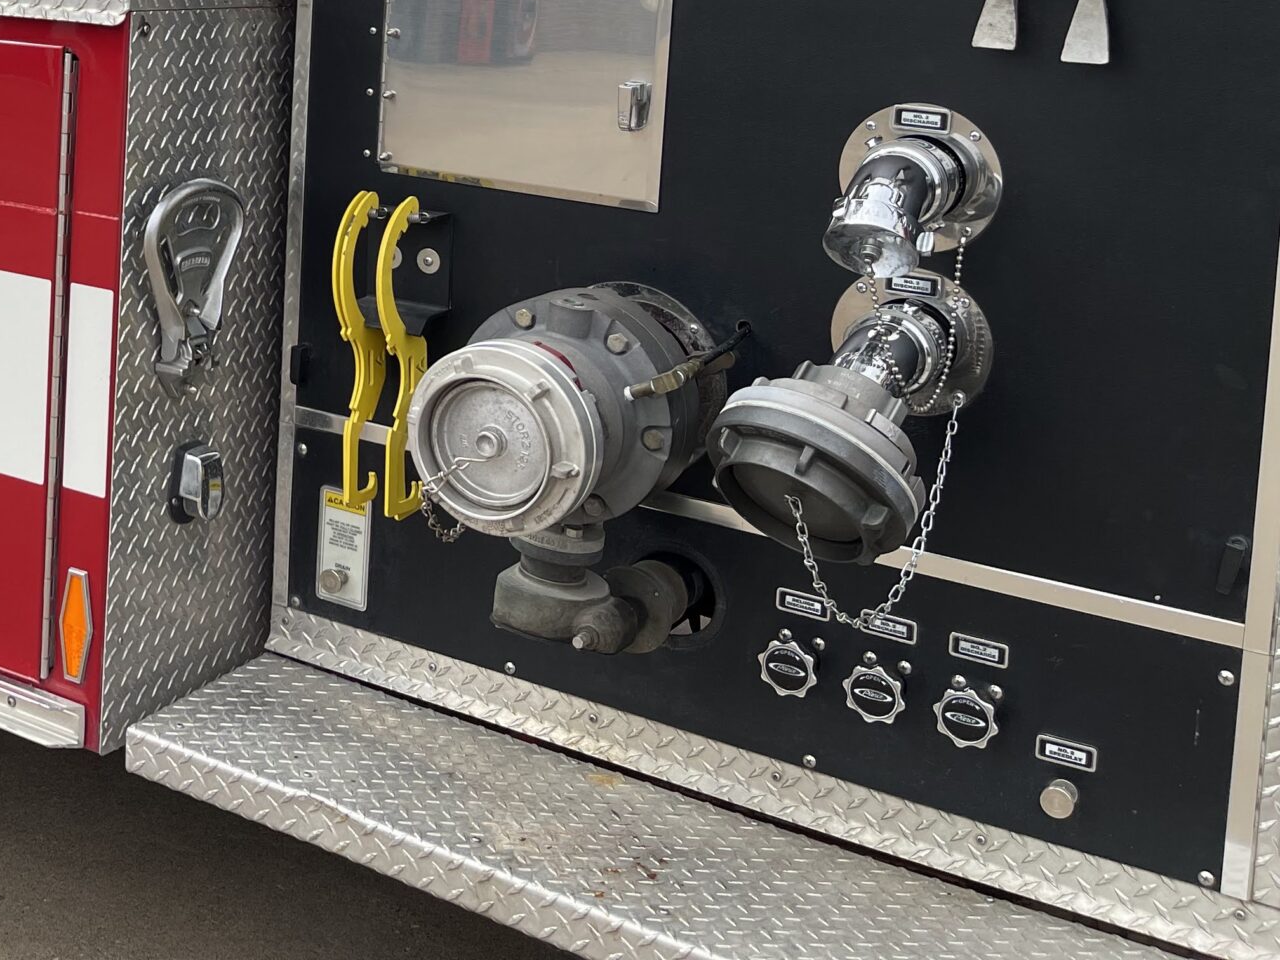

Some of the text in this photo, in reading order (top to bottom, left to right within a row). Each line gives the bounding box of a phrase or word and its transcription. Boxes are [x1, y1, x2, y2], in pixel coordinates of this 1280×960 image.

[902, 117, 939, 126] DISCHARGE
[893, 282, 929, 292] DISCHARGE
[786, 600, 820, 613] DISCHARGE
[960, 646, 996, 659] DISCHARGE
[1048, 749, 1084, 762] SPEEDLAY
